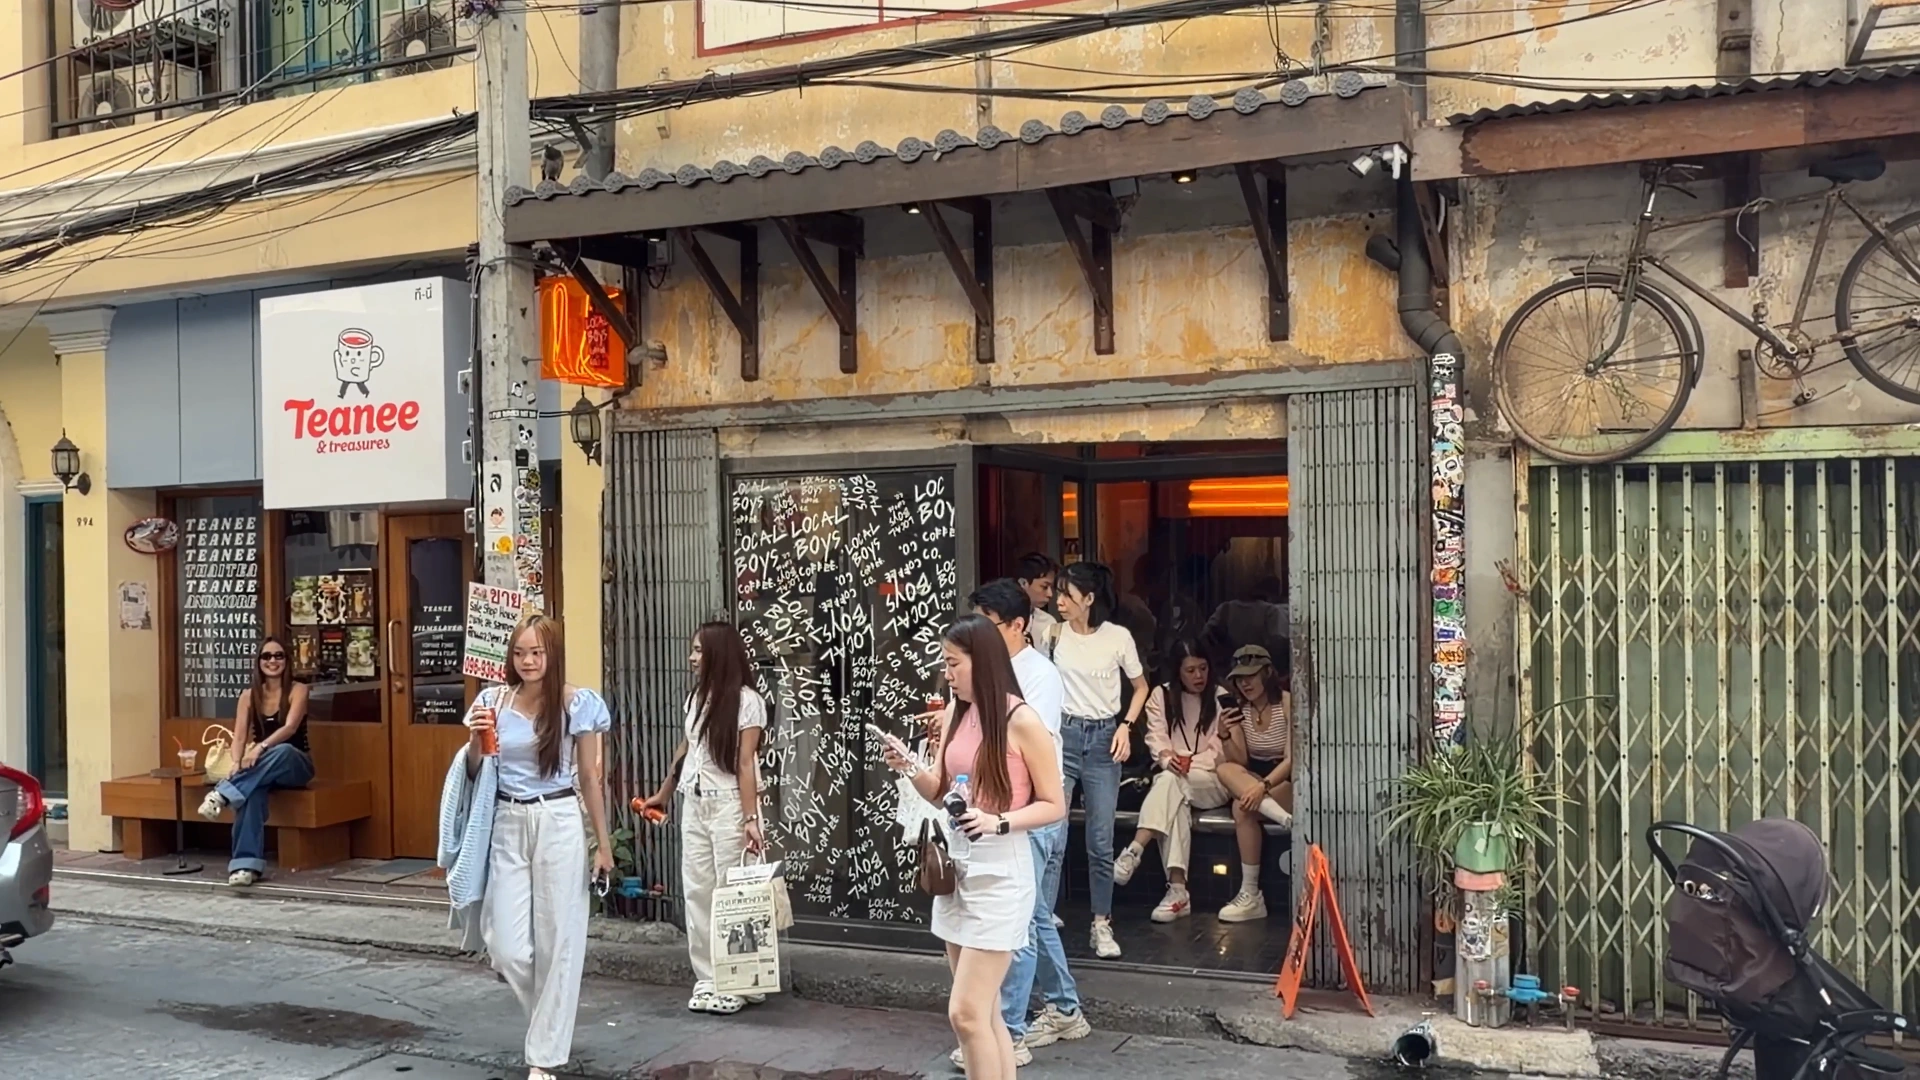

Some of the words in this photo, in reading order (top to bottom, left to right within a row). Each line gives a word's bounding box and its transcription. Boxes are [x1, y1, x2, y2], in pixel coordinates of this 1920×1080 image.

[284, 398, 420, 439] Teanee
[316, 440, 327, 453] &
[329, 438, 390, 453] treasures
[185, 517, 257, 531] TEANEE
[791, 505, 849, 539] LOCAL
[185, 533, 257, 547] TEANEE
[793, 530, 841, 563] BOYS
[845, 522, 880, 556] LOCAL
[852, 537, 880, 568] BOYS
[185, 548, 257, 562] TEANEE
[734, 548, 779, 581] BOYS
[185, 579, 257, 593] TEANEE
[490, 588, 521, 609] ขาย
[886, 569, 932, 612] BOYS
[184, 612, 257, 625] FILMSLAYER
[763, 604, 806, 648] BOYS
[777, 590, 823, 645] LOCAL
[823, 603, 868, 643] BOYS
[883, 592, 940, 637] LOCAL
[184, 628, 257, 639] FILMSLAYER
[184, 642, 257, 655] FILMSLAYER
[820, 624, 875, 667] LOCAL
[912, 626, 945, 668] BOY
[852, 655, 883, 667] LOCAL
[853, 666, 877, 681] BOYS
[184, 673, 254, 684] FILMSLAYE
[773, 656, 801, 722] LOCAL
[794, 666, 823, 719] BOYS
[882, 673, 920, 701] LOCAL
[876, 685, 908, 711] BOYS
[865, 741, 885, 757] BOY
[828, 749, 858, 797] LOCAL
[779, 772, 811, 834] LOCAL
[794, 790, 828, 844] BOYS
[853, 797, 894, 832] LOCAL
[784, 850, 815, 860] LOCAL
[785, 861, 809, 875] BOYS
[848, 851, 883, 882] BOYS
[894, 850, 918, 867] BO
[848, 867, 889, 900] LOCAL
[868, 898, 899, 908] LOCAL
[868, 909, 894, 921] BOYS
